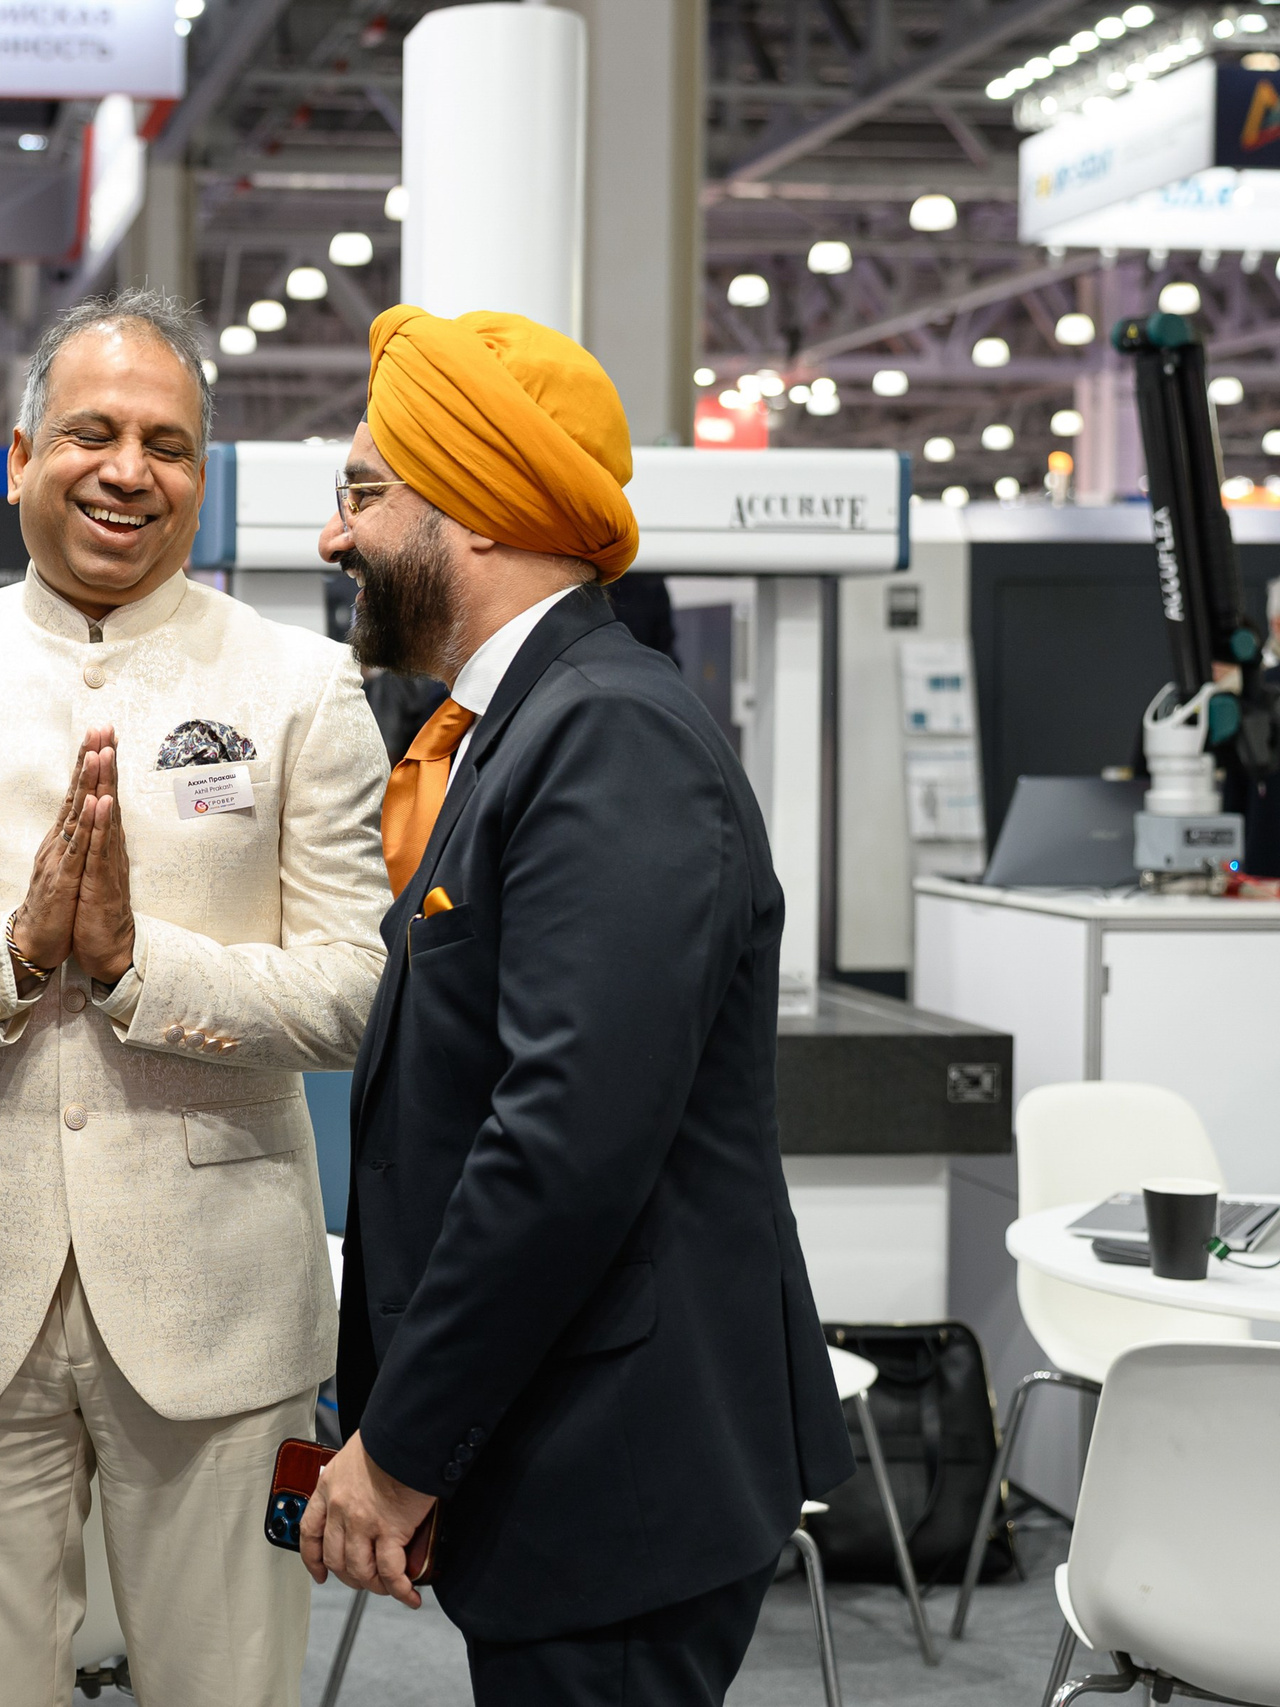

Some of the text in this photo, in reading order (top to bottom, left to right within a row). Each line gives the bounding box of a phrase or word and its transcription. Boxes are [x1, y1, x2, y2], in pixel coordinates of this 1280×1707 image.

[729, 493, 867, 530] ACCURATE
[188, 773, 236, 787] Акхил Пракаш
[194, 783, 234, 795] Akhil Prakash
